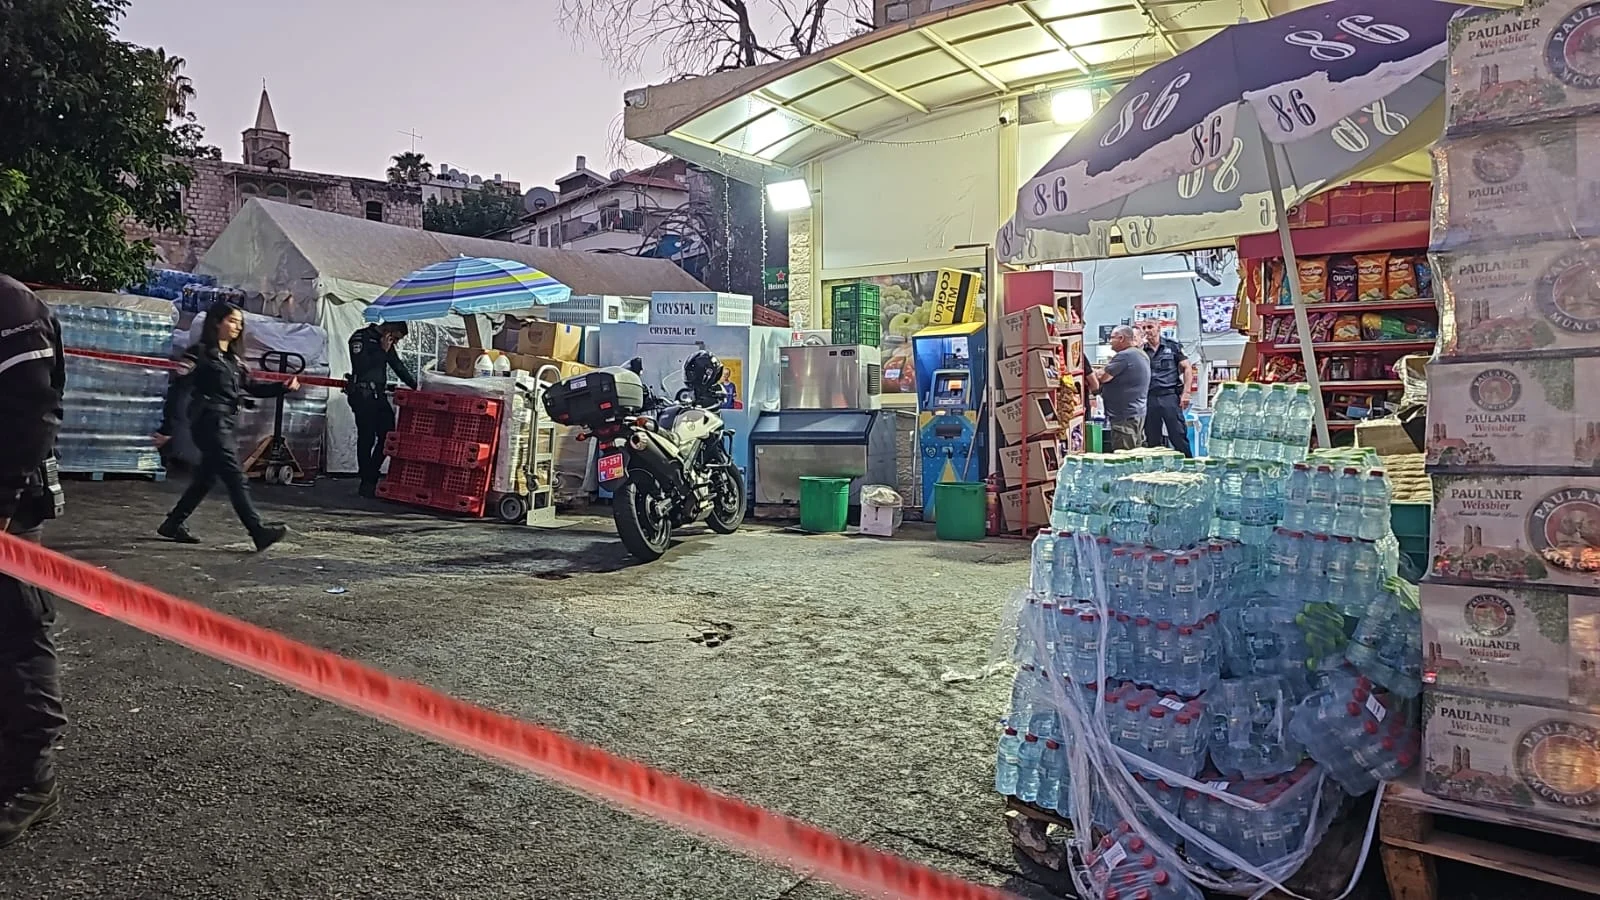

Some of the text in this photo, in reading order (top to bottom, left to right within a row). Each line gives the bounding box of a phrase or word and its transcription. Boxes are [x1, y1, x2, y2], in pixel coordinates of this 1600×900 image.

[1468, 17, 1540, 41] PAULANER
[1553, 6, 1600, 42] PAUL
[1479, 33, 1530, 49] Weissbier
[1467, 182, 1528, 199] PAULANER
[1459, 258, 1529, 275] PAULANER
[945, 287, 958, 313] ATM
[656, 302, 714, 315] CRYSTAL ICE
[649, 326, 697, 336] CRYSTAL ICE
[1465, 414, 1526, 424] PAULANER
[1474, 423, 1517, 432] Weissbier
[1451, 488, 1522, 501] PAULANER
[1462, 500, 1511, 510] Weissbier
[1460, 637, 1521, 652] PAULANER
[1469, 648, 1511, 658] Weissbier
[1441, 706, 1511, 727] PAULANER
[1451, 720, 1499, 735] Weissbier
